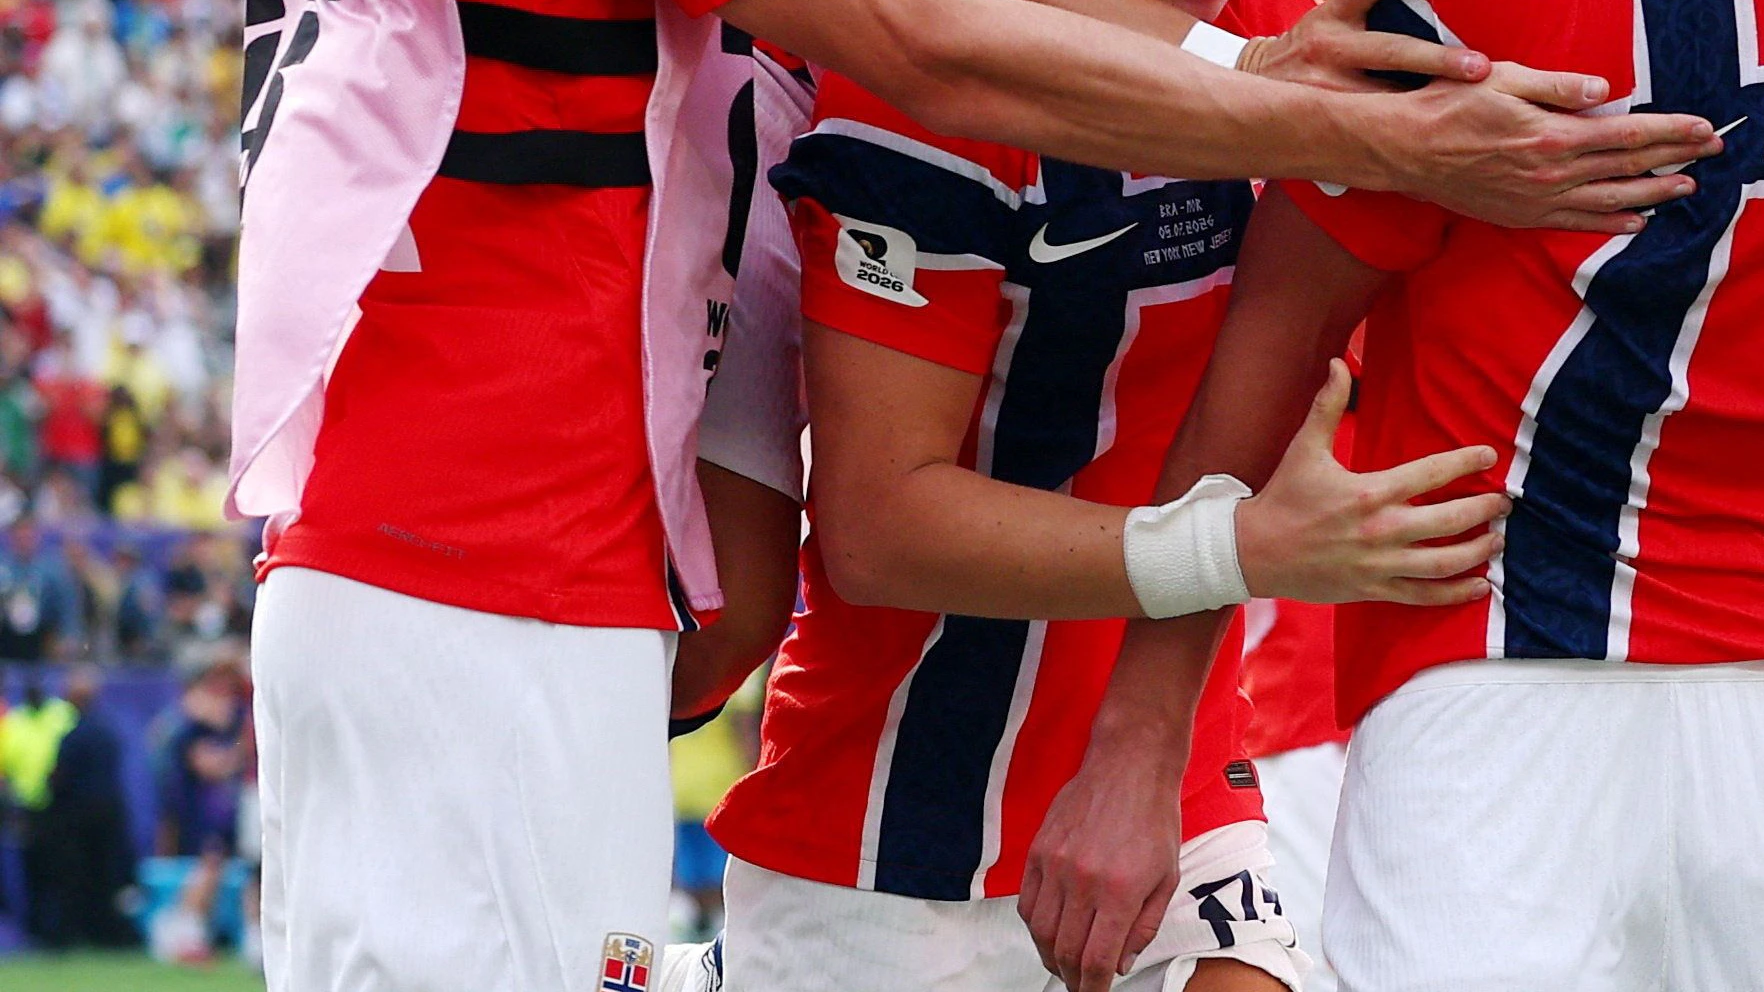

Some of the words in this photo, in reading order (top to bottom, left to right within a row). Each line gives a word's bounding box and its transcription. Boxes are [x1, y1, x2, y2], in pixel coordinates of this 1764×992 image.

[1159, 202, 1179, 218] BRA
[1181, 240, 1205, 258] NEW
[860, 260, 888, 275] WORLD
[857, 269, 904, 293] 2026
